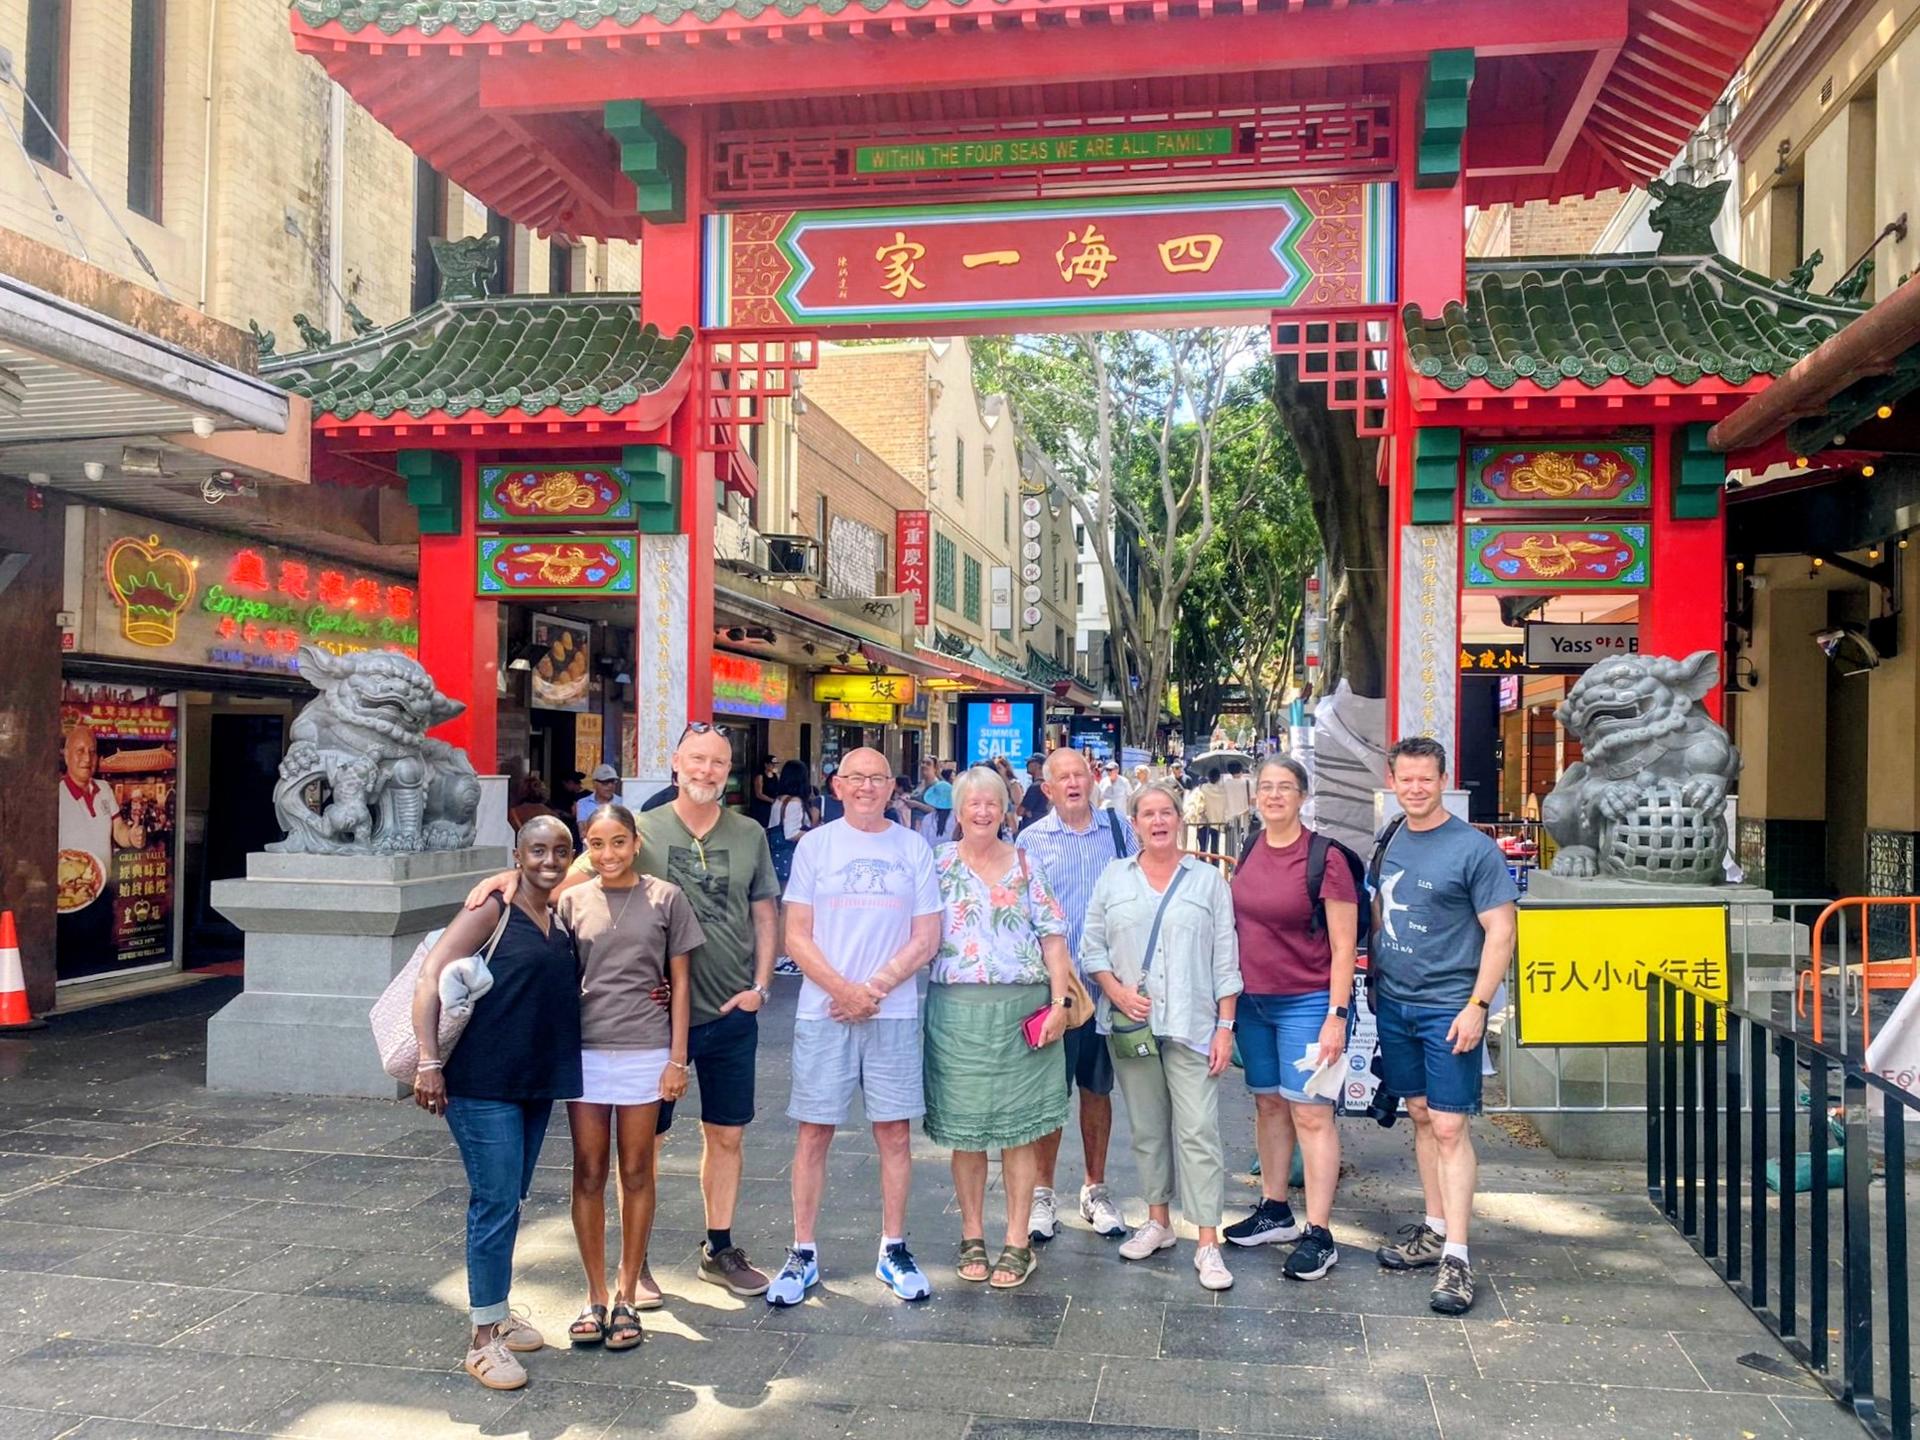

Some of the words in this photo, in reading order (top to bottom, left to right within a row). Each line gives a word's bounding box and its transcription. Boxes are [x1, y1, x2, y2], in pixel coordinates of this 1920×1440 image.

[872, 149, 925, 168] WITHIN
[931, 146, 959, 165] THE
[965, 143, 1003, 163] FOUR
[1009, 142, 1048, 161] SEAS
[1055, 139, 1079, 158] WE
[1084, 137, 1114, 157] ARE
[1121, 135, 1149, 154] ALL
[1156, 133, 1215, 153] FAMILY
[1551, 636, 1592, 653] Yass
[1595, 636, 1624, 648] 야스
[1629, 637, 1639, 653] B
[1461, 648, 1540, 669] 金陵小
[980, 728, 1020, 738] SUMMER
[978, 738, 1022, 759] SALE
[1526, 957, 1722, 994] 行人小心行走
[1347, 1100, 1370, 1108] MAINT
